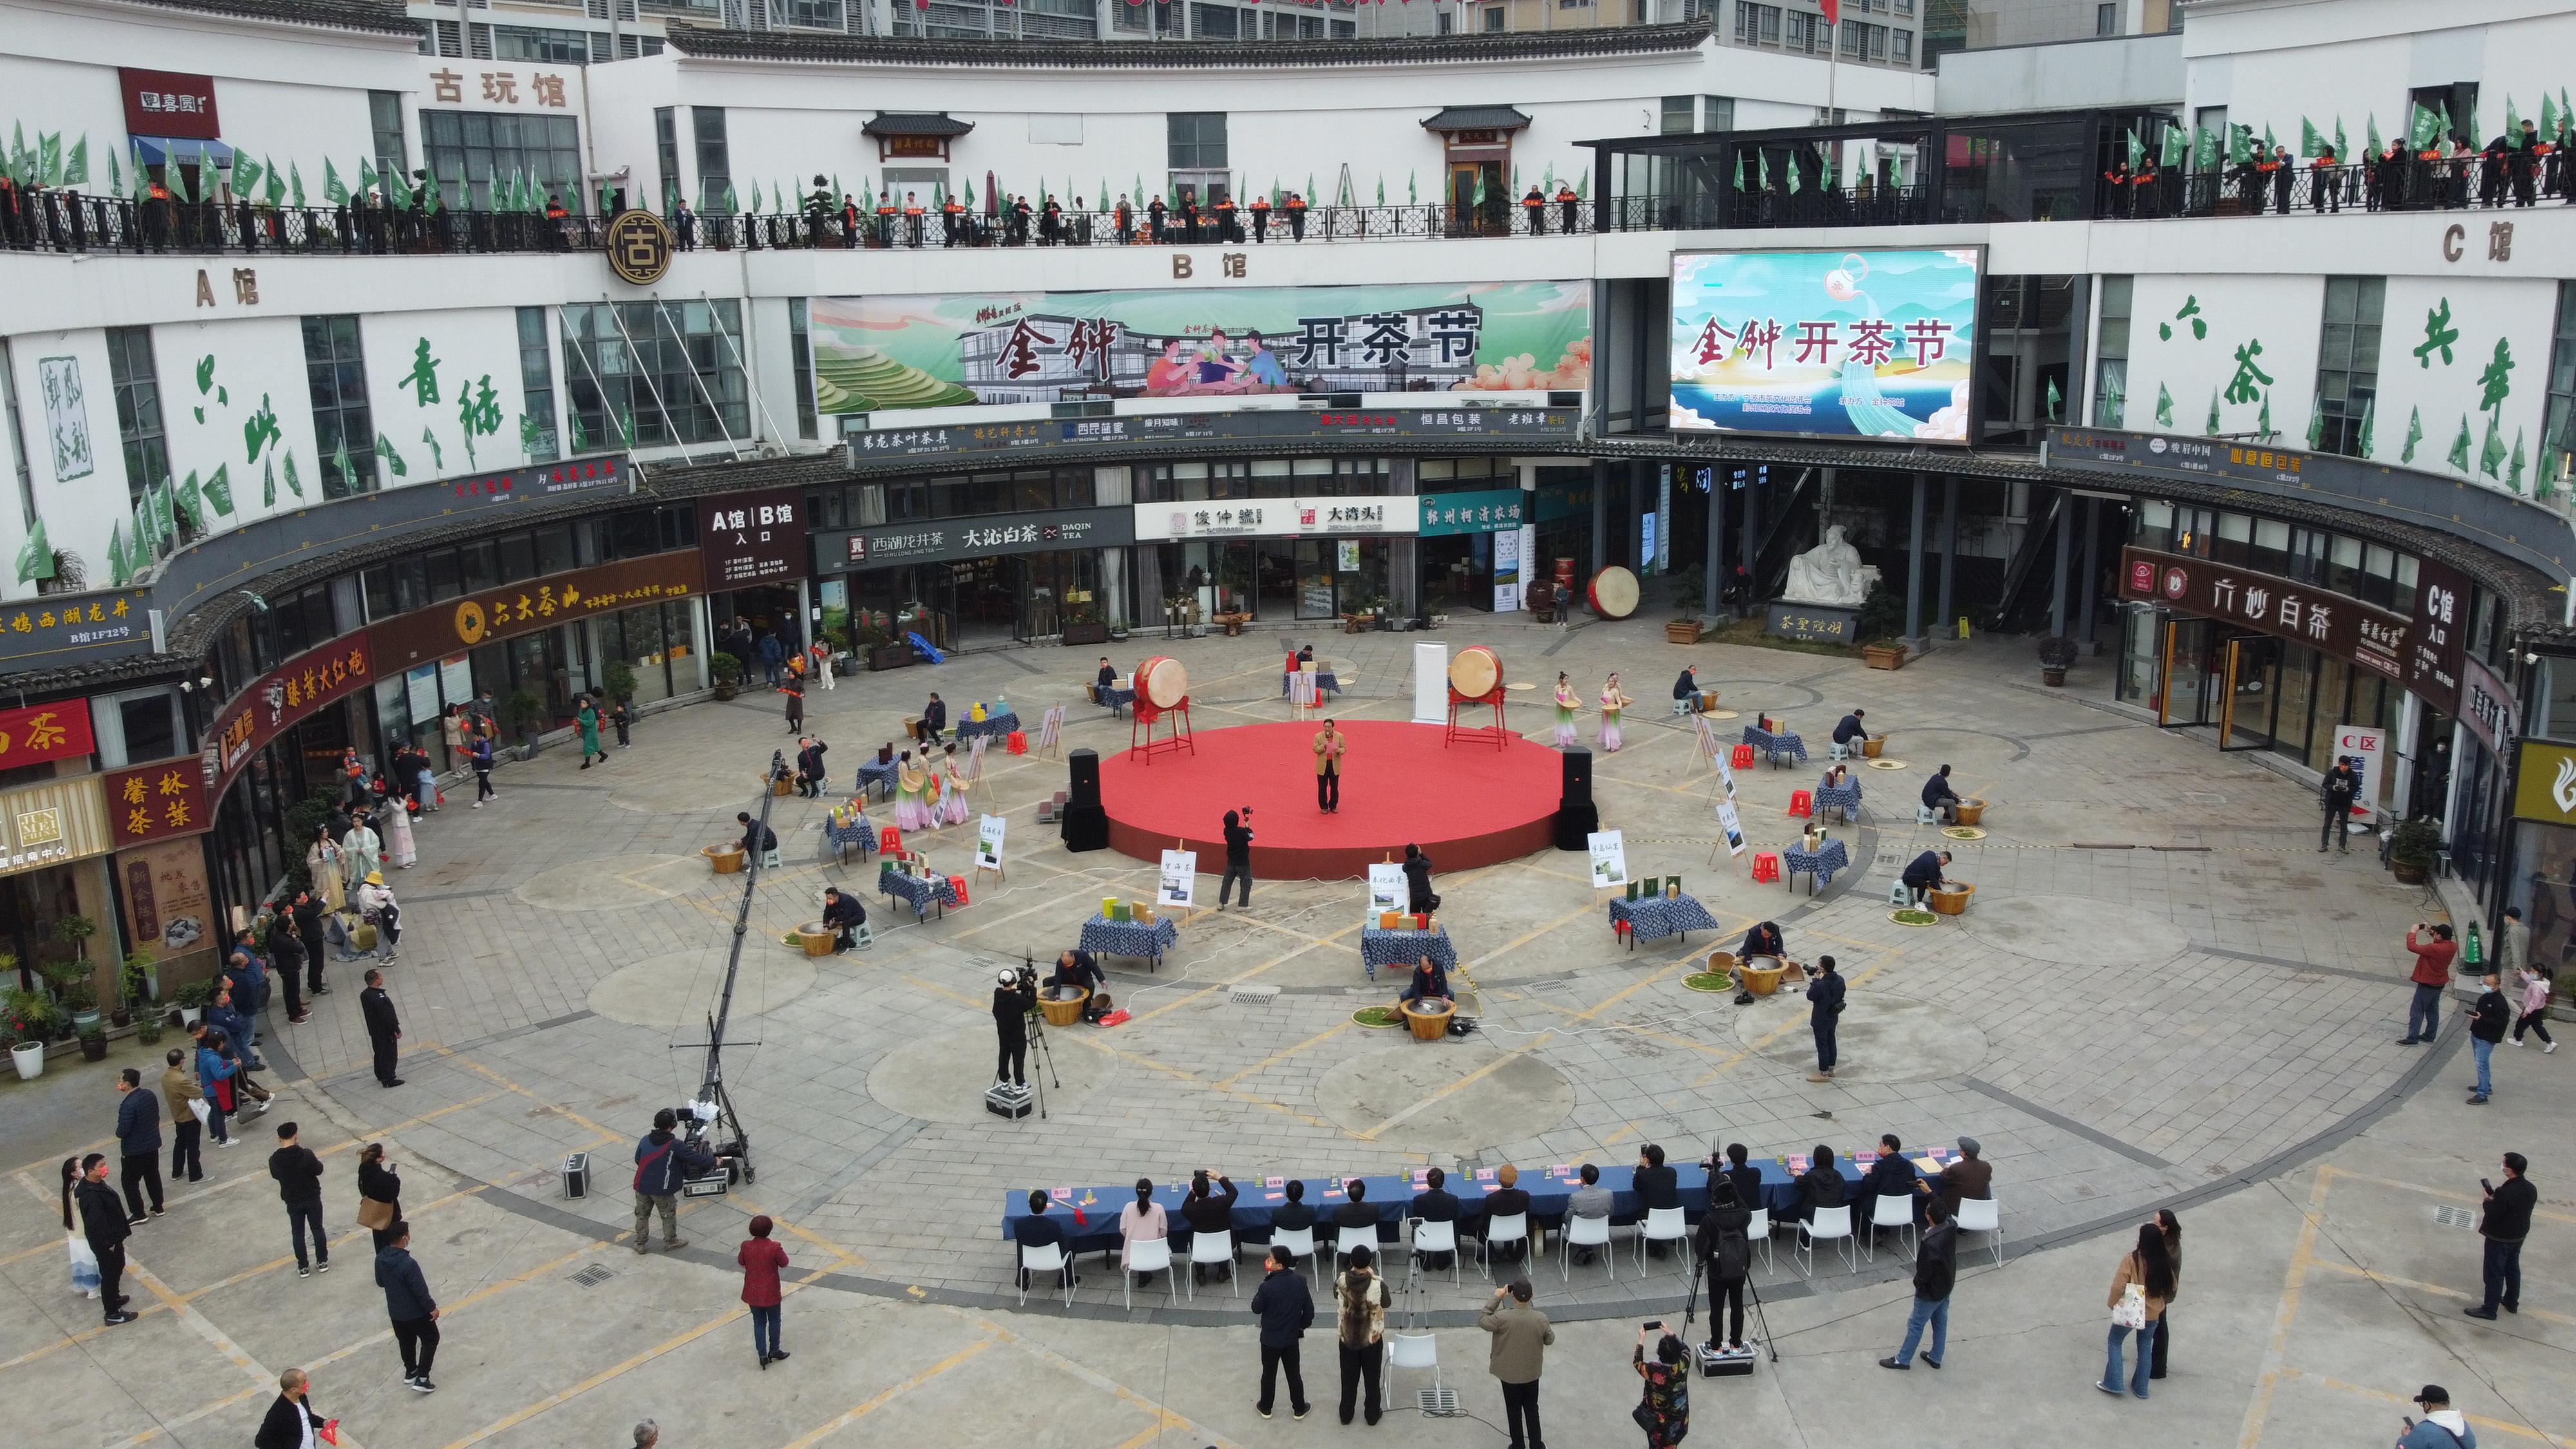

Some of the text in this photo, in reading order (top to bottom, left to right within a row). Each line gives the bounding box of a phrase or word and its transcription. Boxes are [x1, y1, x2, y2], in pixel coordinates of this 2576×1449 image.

[430, 68, 566, 107] 古玩馆
[623, 228, 656, 265] 古
[2443, 221, 2514, 262] C馆
[1172, 252, 1247, 279] B馆
[197, 267, 259, 307] A馆
[994, 308, 1482, 383] 金钟 开茶节
[1690, 316, 1953, 370] 金钟开茶节
[2159, 294, 2274, 405] 六茶
[399, 337, 504, 437] 青绿
[1421, 413, 1481, 426] 恒昌包装
[2171, 442, 2210, 457] 骏眉中国
[712, 504, 793, 531] A馆 B馆
[1062, 522, 1091, 531] DAQIN
[736, 531, 770, 545] 入口
[873, 531, 944, 552] 西湖龙井茶
[962, 524, 1038, 548] 大沁白茶
[2215, 578, 2332, 641] 六妙白茶
[2428, 585, 2455, 624] C馆
[1779, 615, 1842, 634] 茶聖陸羽
[2428, 623, 2445, 645] 入口
[2342, 735, 2377, 751] C区
[23, 820, 57, 833] MEI
[24, 829, 58, 840] CHINA
